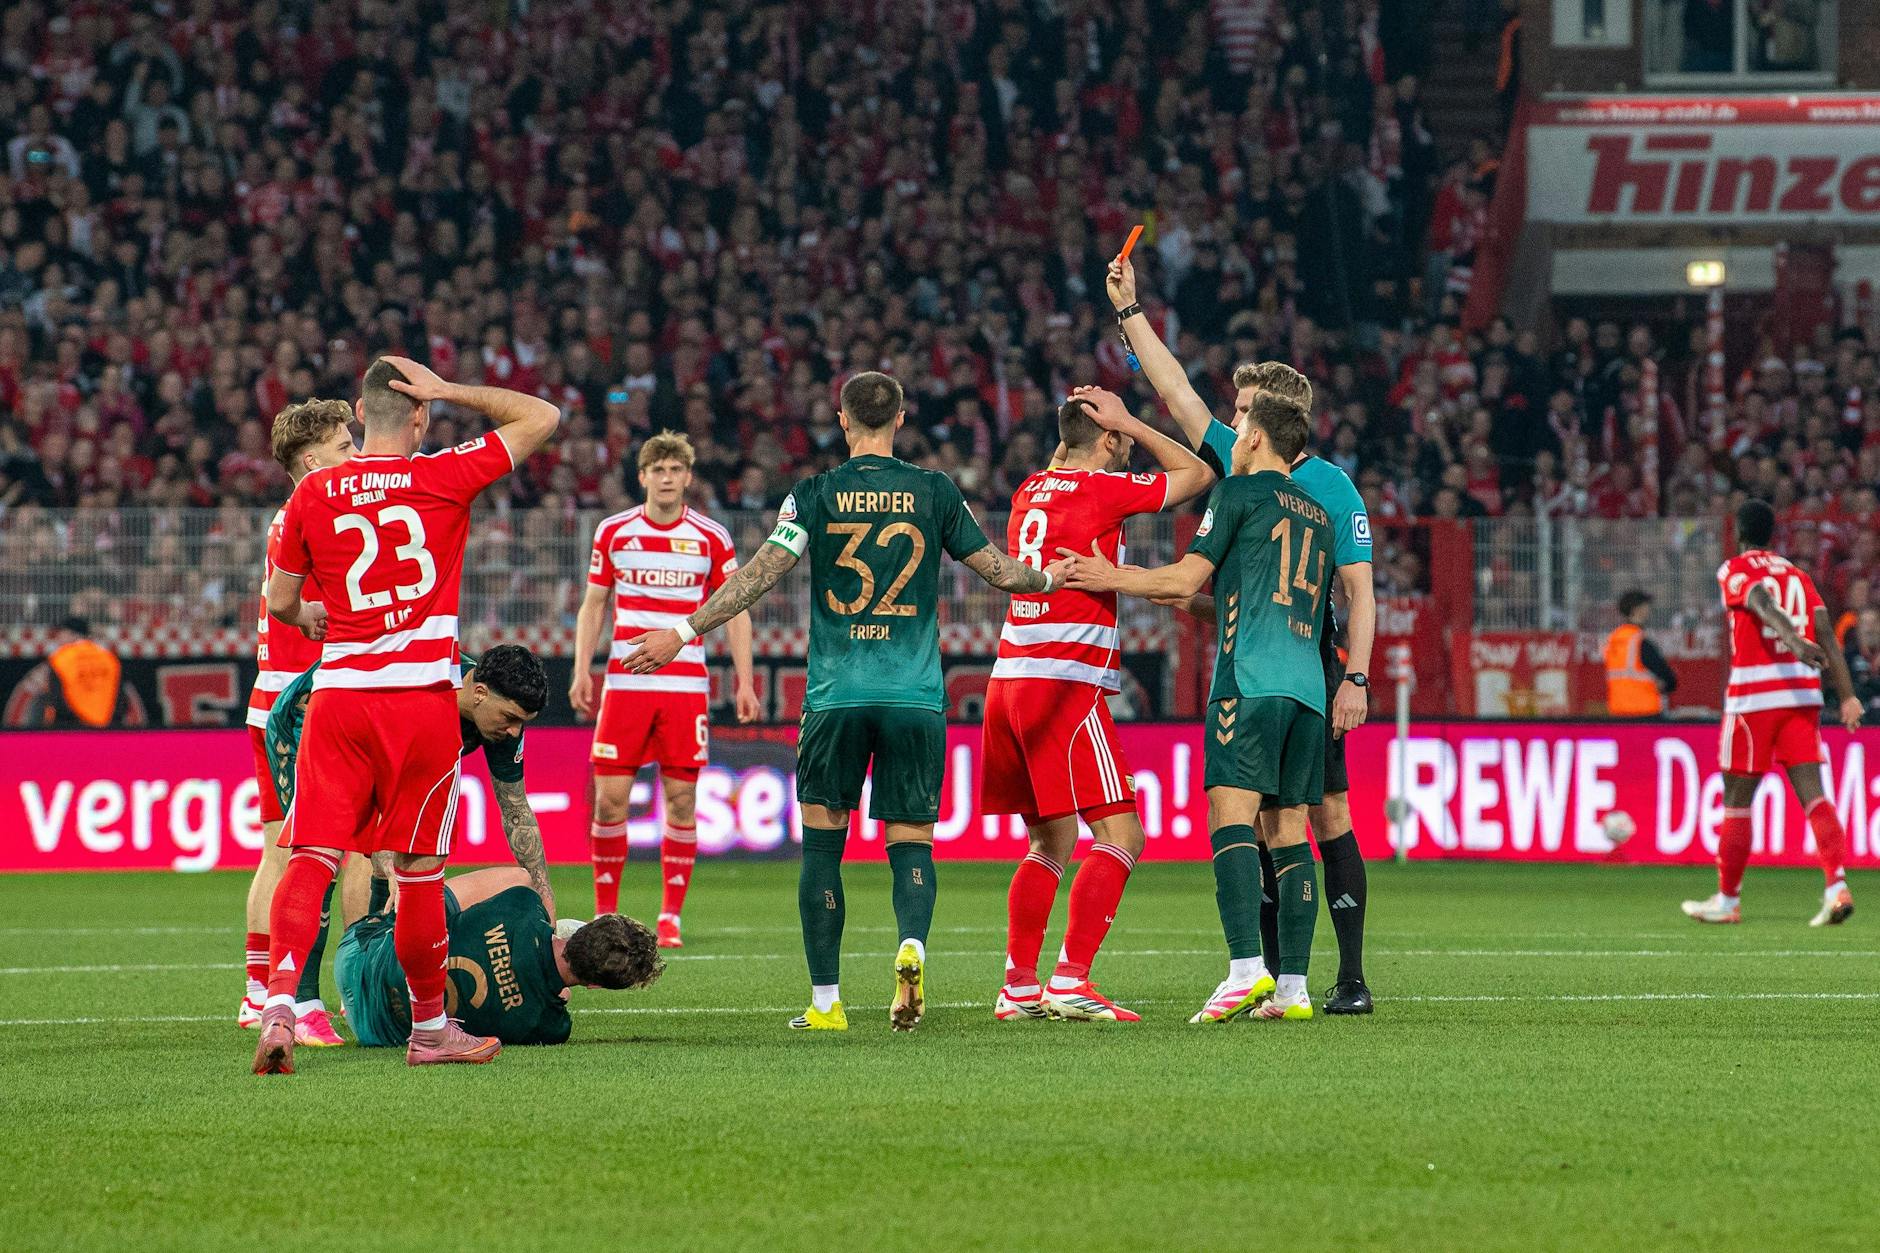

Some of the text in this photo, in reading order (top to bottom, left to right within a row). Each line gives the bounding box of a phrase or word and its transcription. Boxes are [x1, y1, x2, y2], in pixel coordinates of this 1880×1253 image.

[1587, 133, 1880, 213] hinze
[325, 472, 412, 498] 1. FC UNION
[352, 488, 386, 507] BERLIN
[836, 491, 915, 513] WERDER
[1273, 489, 1329, 528] WERDER
[333, 505, 437, 612] 23
[826, 521, 926, 616] 32
[1017, 508, 1048, 573] 8
[1271, 517, 1326, 618] 14
[636, 567, 696, 586] raisin
[849, 623, 891, 641] FRIEDL
[1386, 737, 1880, 859] REWE Den M
[484, 923, 524, 1012] WERDER
